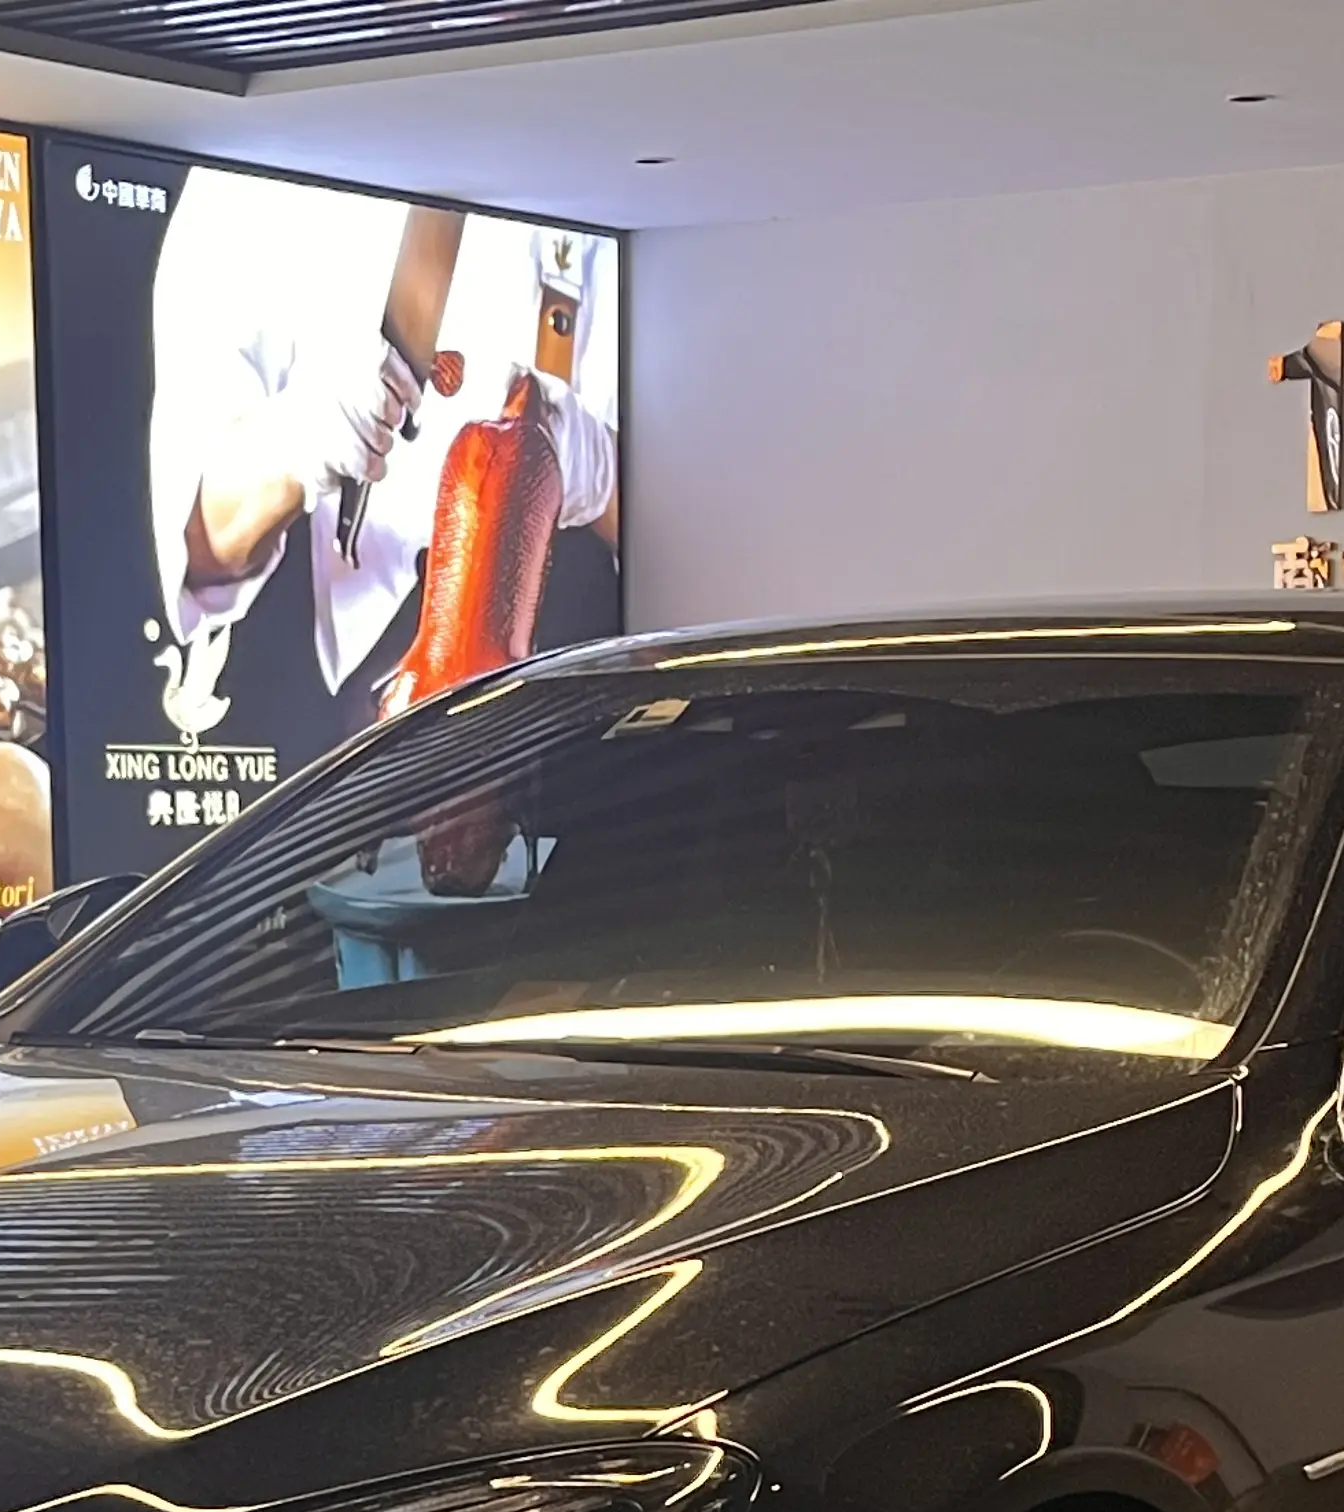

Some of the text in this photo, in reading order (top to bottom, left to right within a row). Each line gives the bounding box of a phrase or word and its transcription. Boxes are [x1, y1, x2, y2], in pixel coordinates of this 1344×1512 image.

[105, 752, 278, 783] XING LONG YUE
